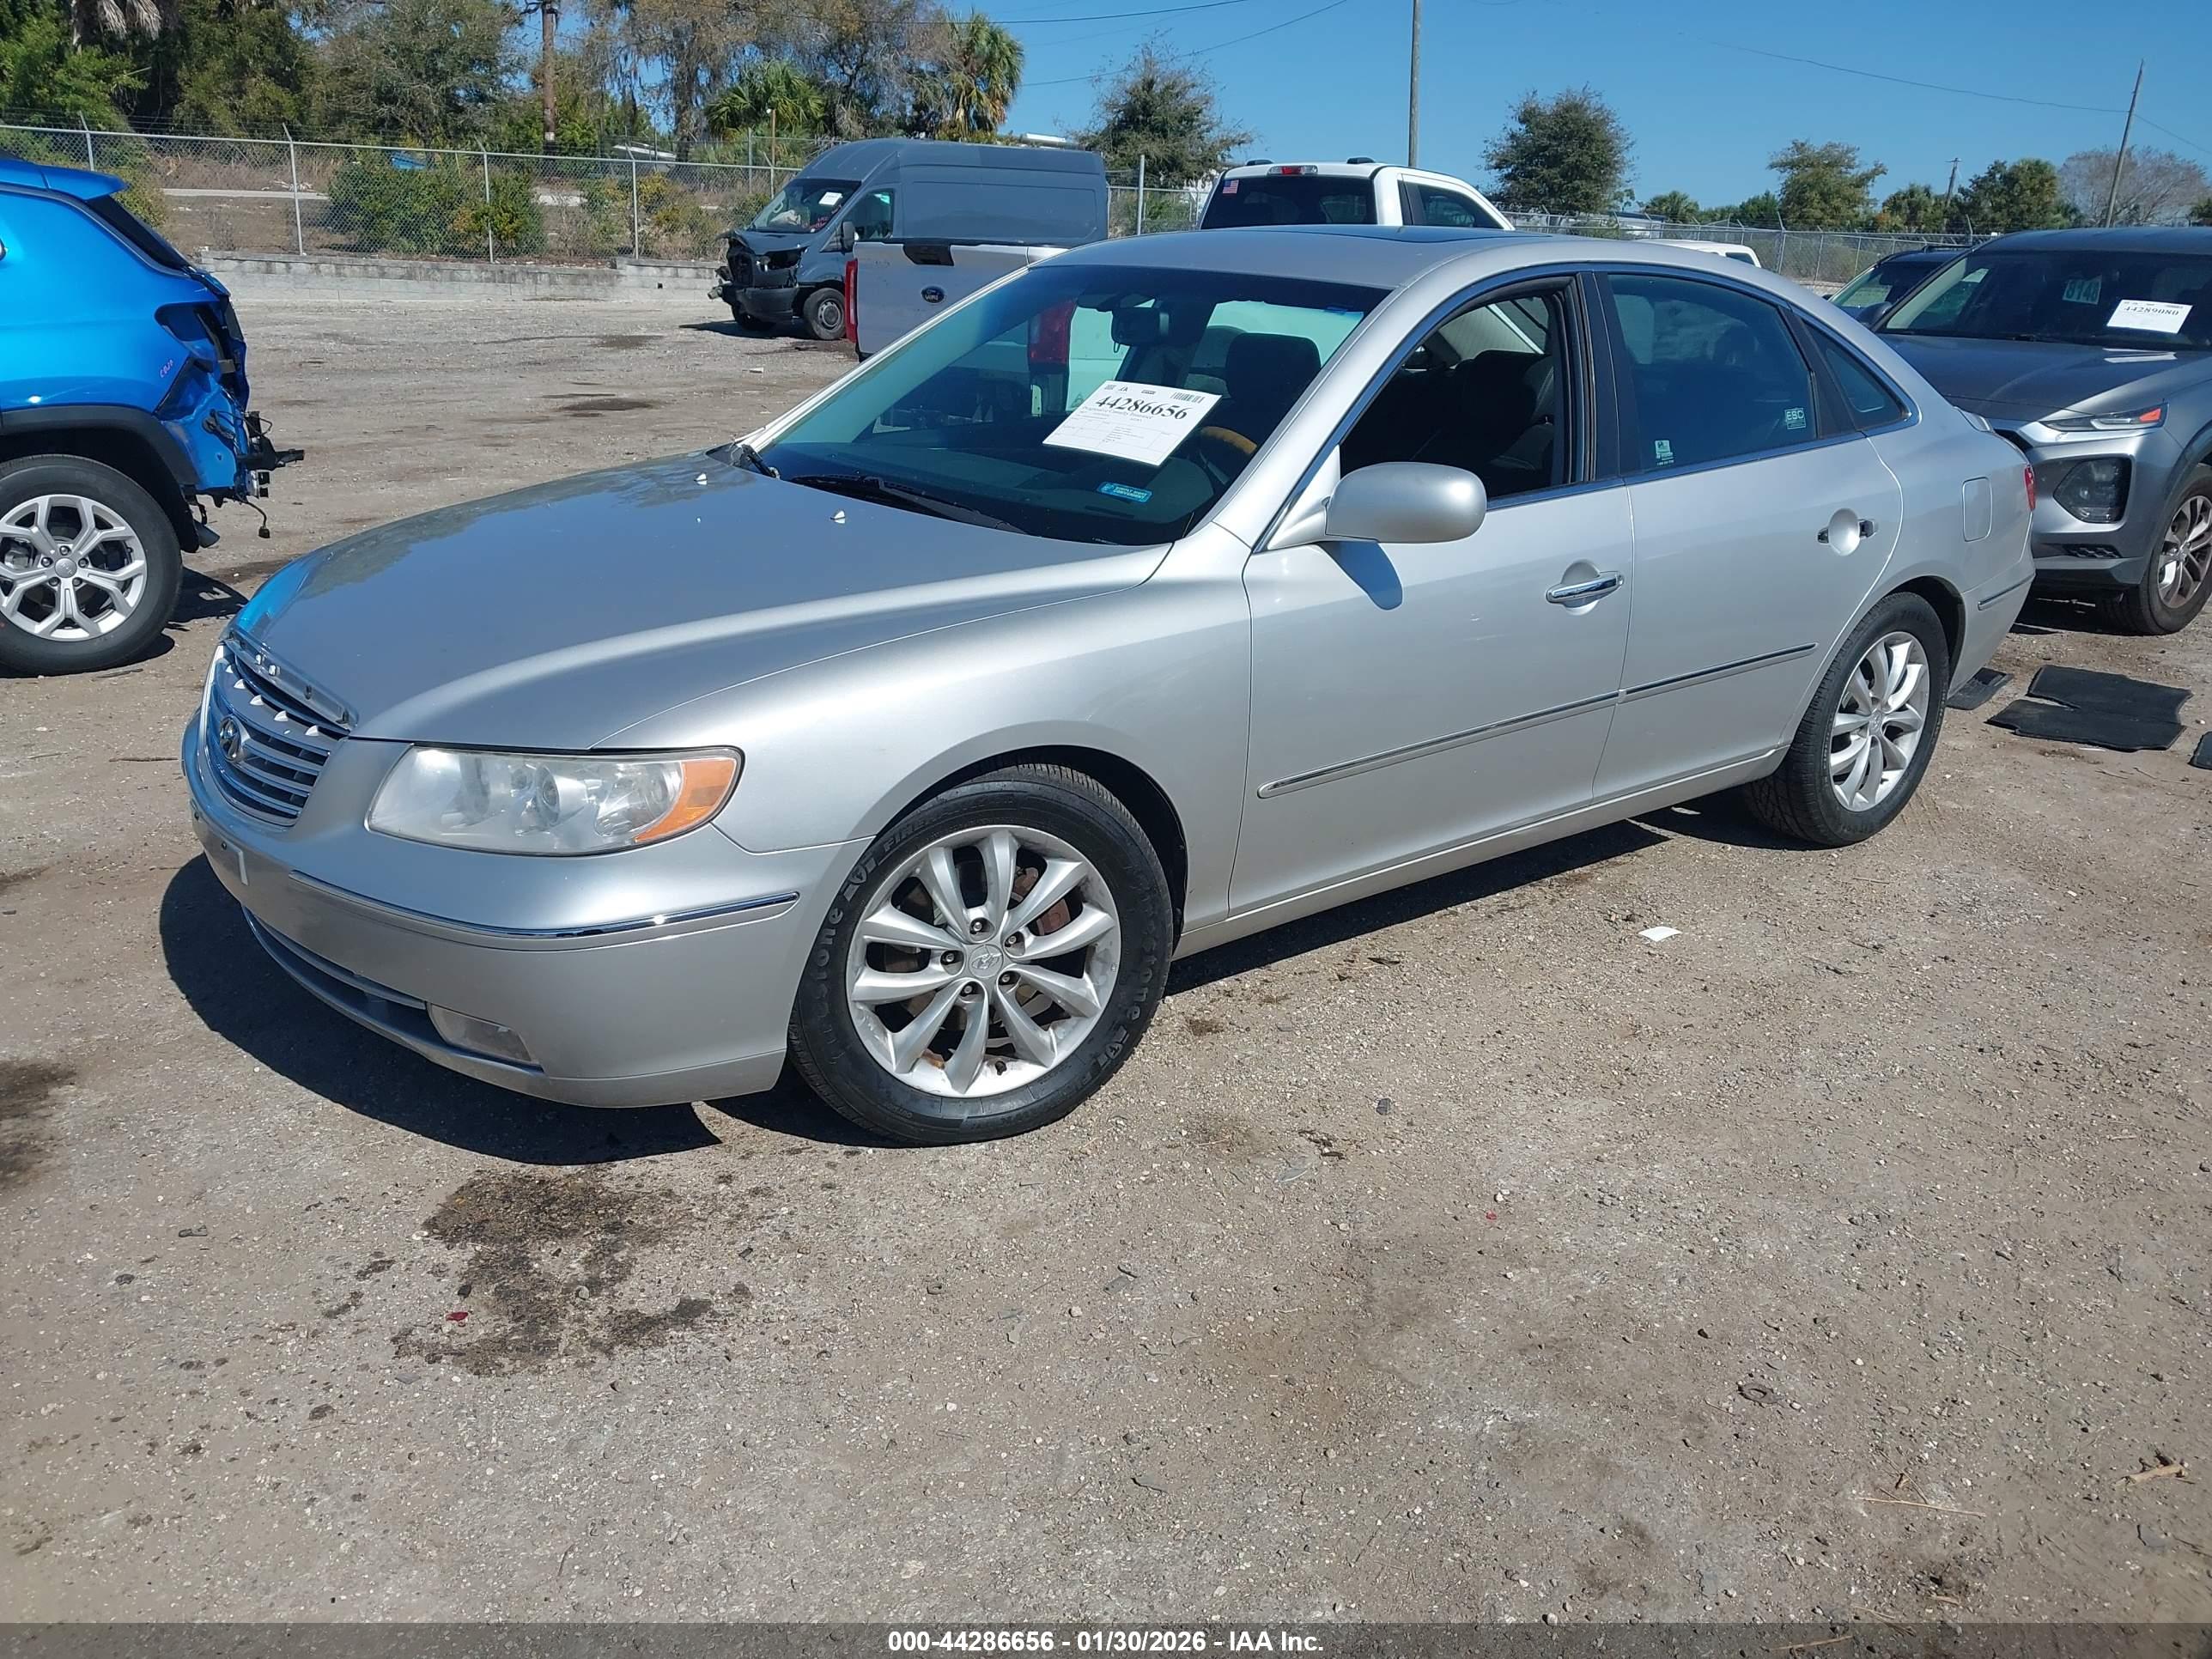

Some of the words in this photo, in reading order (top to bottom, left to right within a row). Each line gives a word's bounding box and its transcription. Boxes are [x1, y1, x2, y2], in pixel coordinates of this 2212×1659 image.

[2124, 306, 2179, 316] 44289080
[1095, 395, 1193, 420] 44286656
[1786, 410, 1804, 421] ESC
